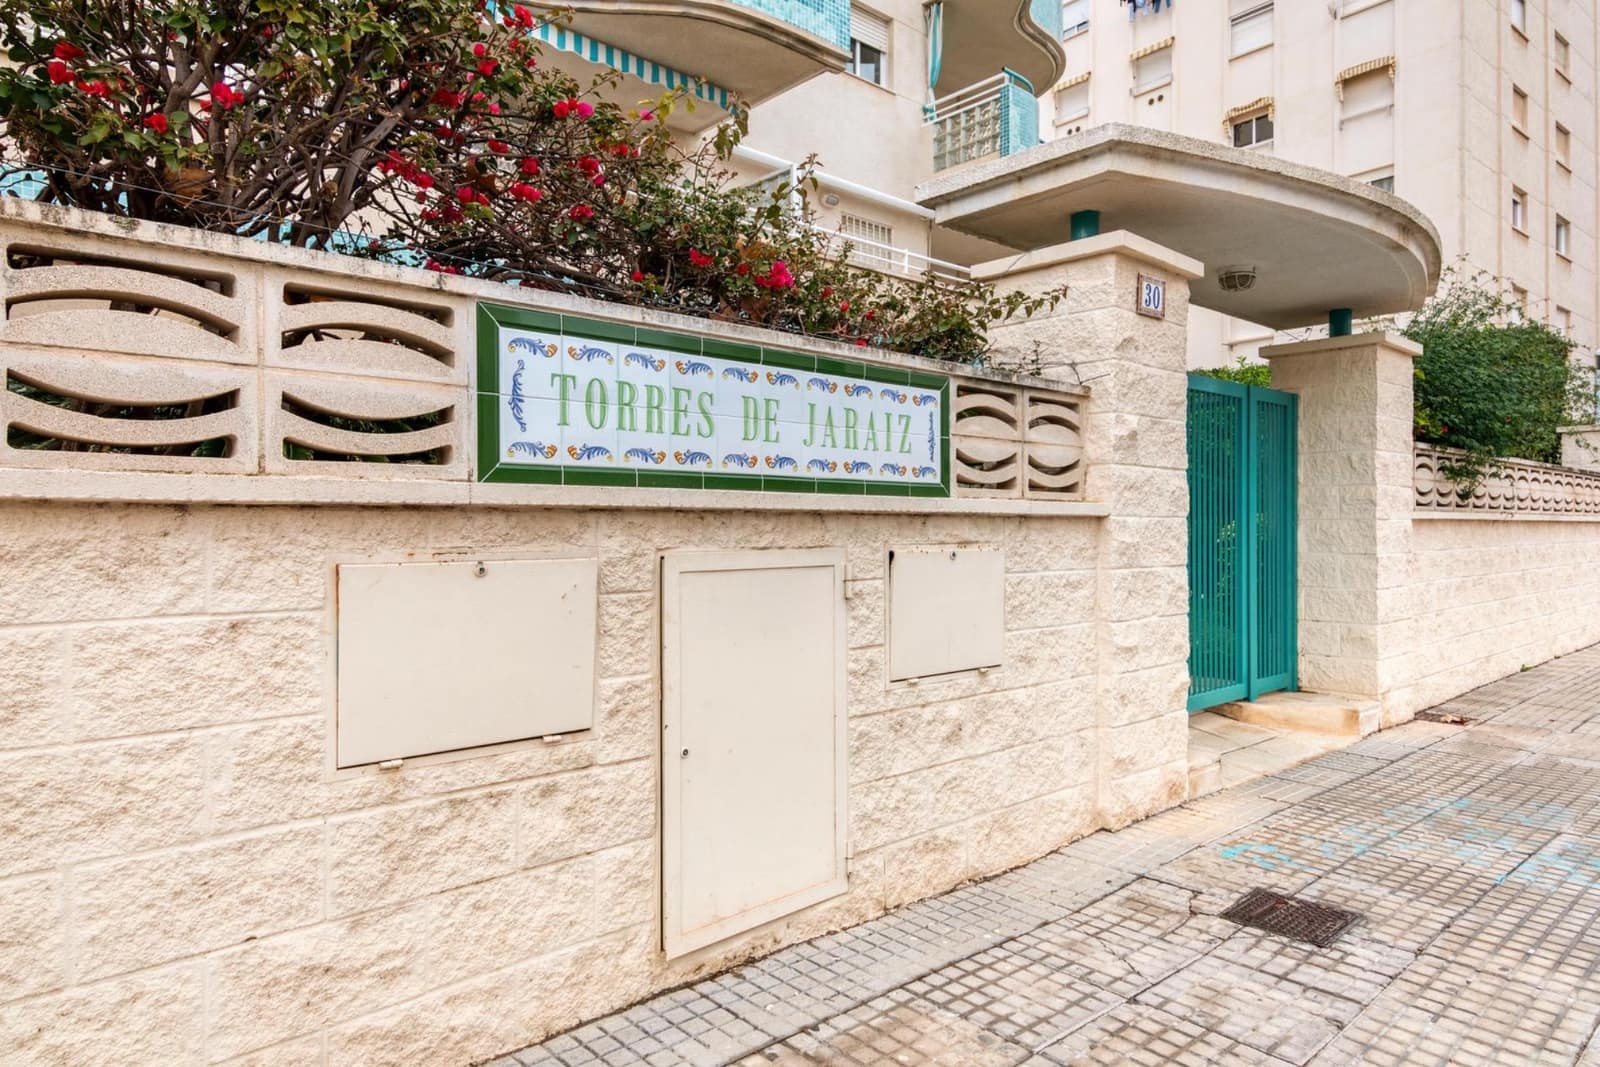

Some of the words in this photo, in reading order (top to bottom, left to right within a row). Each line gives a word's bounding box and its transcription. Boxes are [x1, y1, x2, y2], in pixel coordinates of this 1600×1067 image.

[1145, 283, 1160, 309] 30
[550, 372, 715, 439] TORRES
[741, 394, 781, 443] DE
[802, 402, 913, 454] JARAIZ
